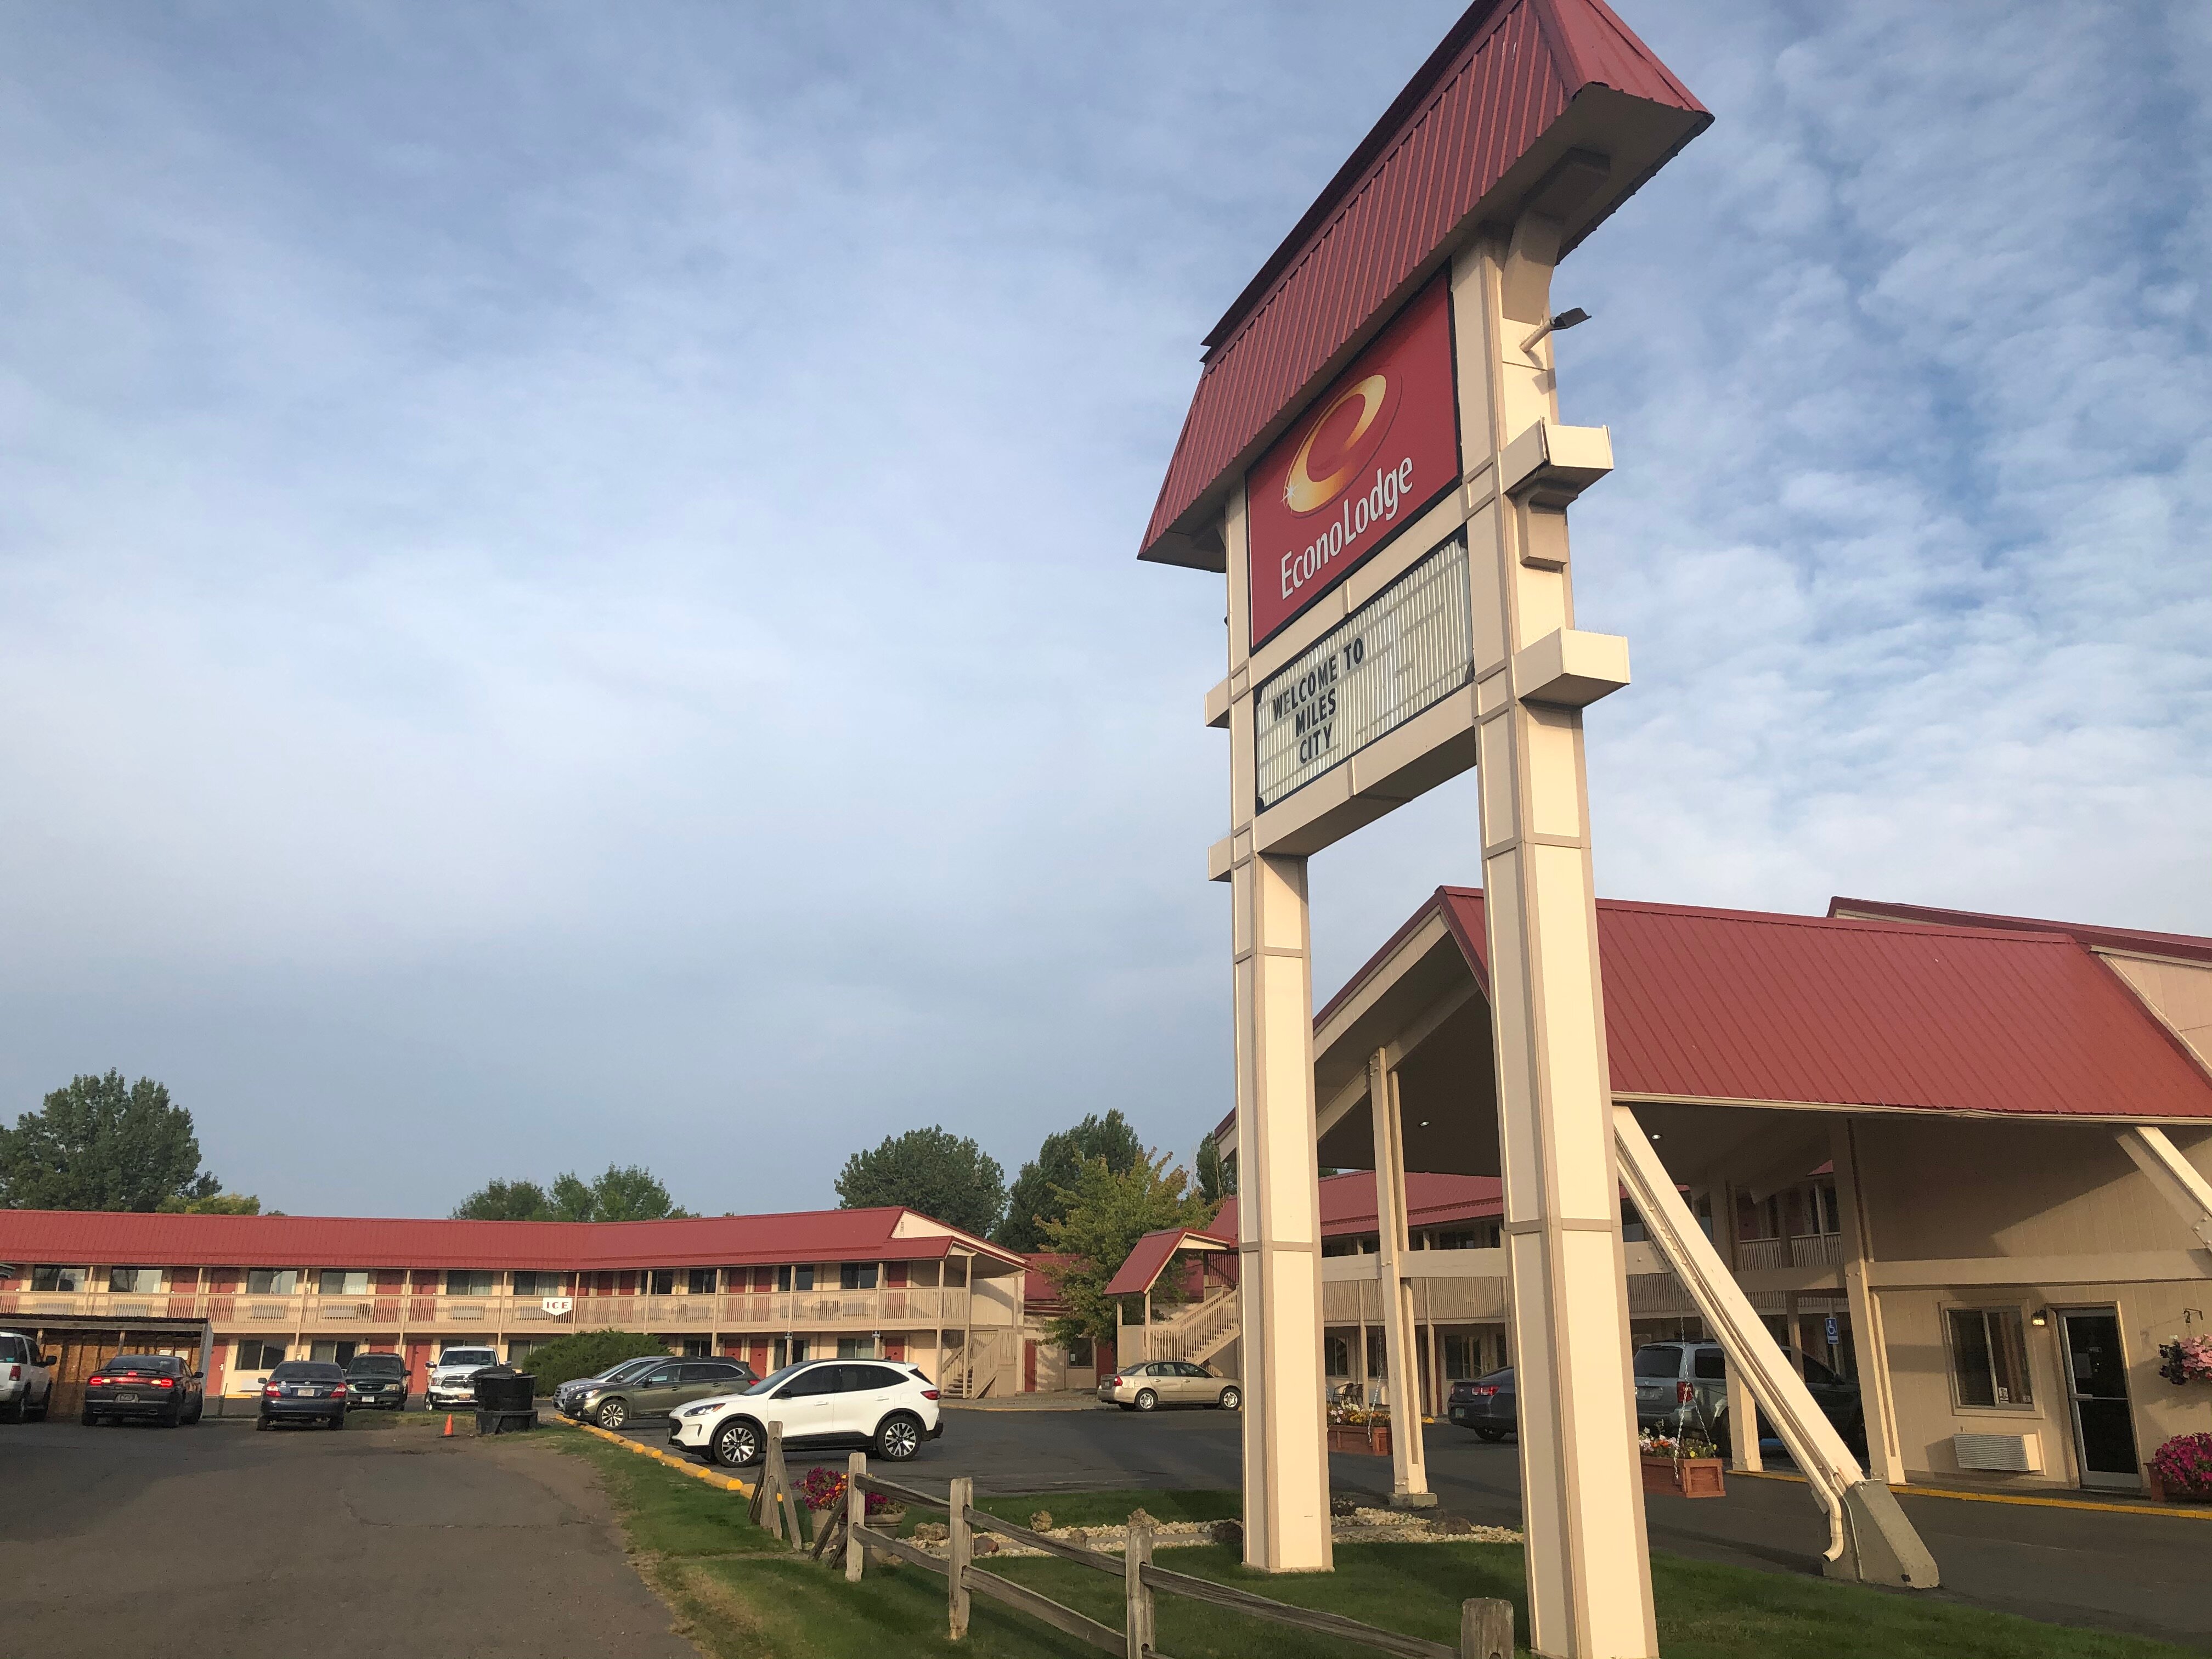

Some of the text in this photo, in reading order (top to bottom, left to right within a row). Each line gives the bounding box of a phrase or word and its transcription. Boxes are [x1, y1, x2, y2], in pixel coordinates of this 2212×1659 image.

[1281, 457, 1413, 600] EconoLodge
[1272, 637, 1363, 722] WELCOME TO
[1296, 687, 1336, 738] MILES
[1299, 721, 1333, 764] CITY
